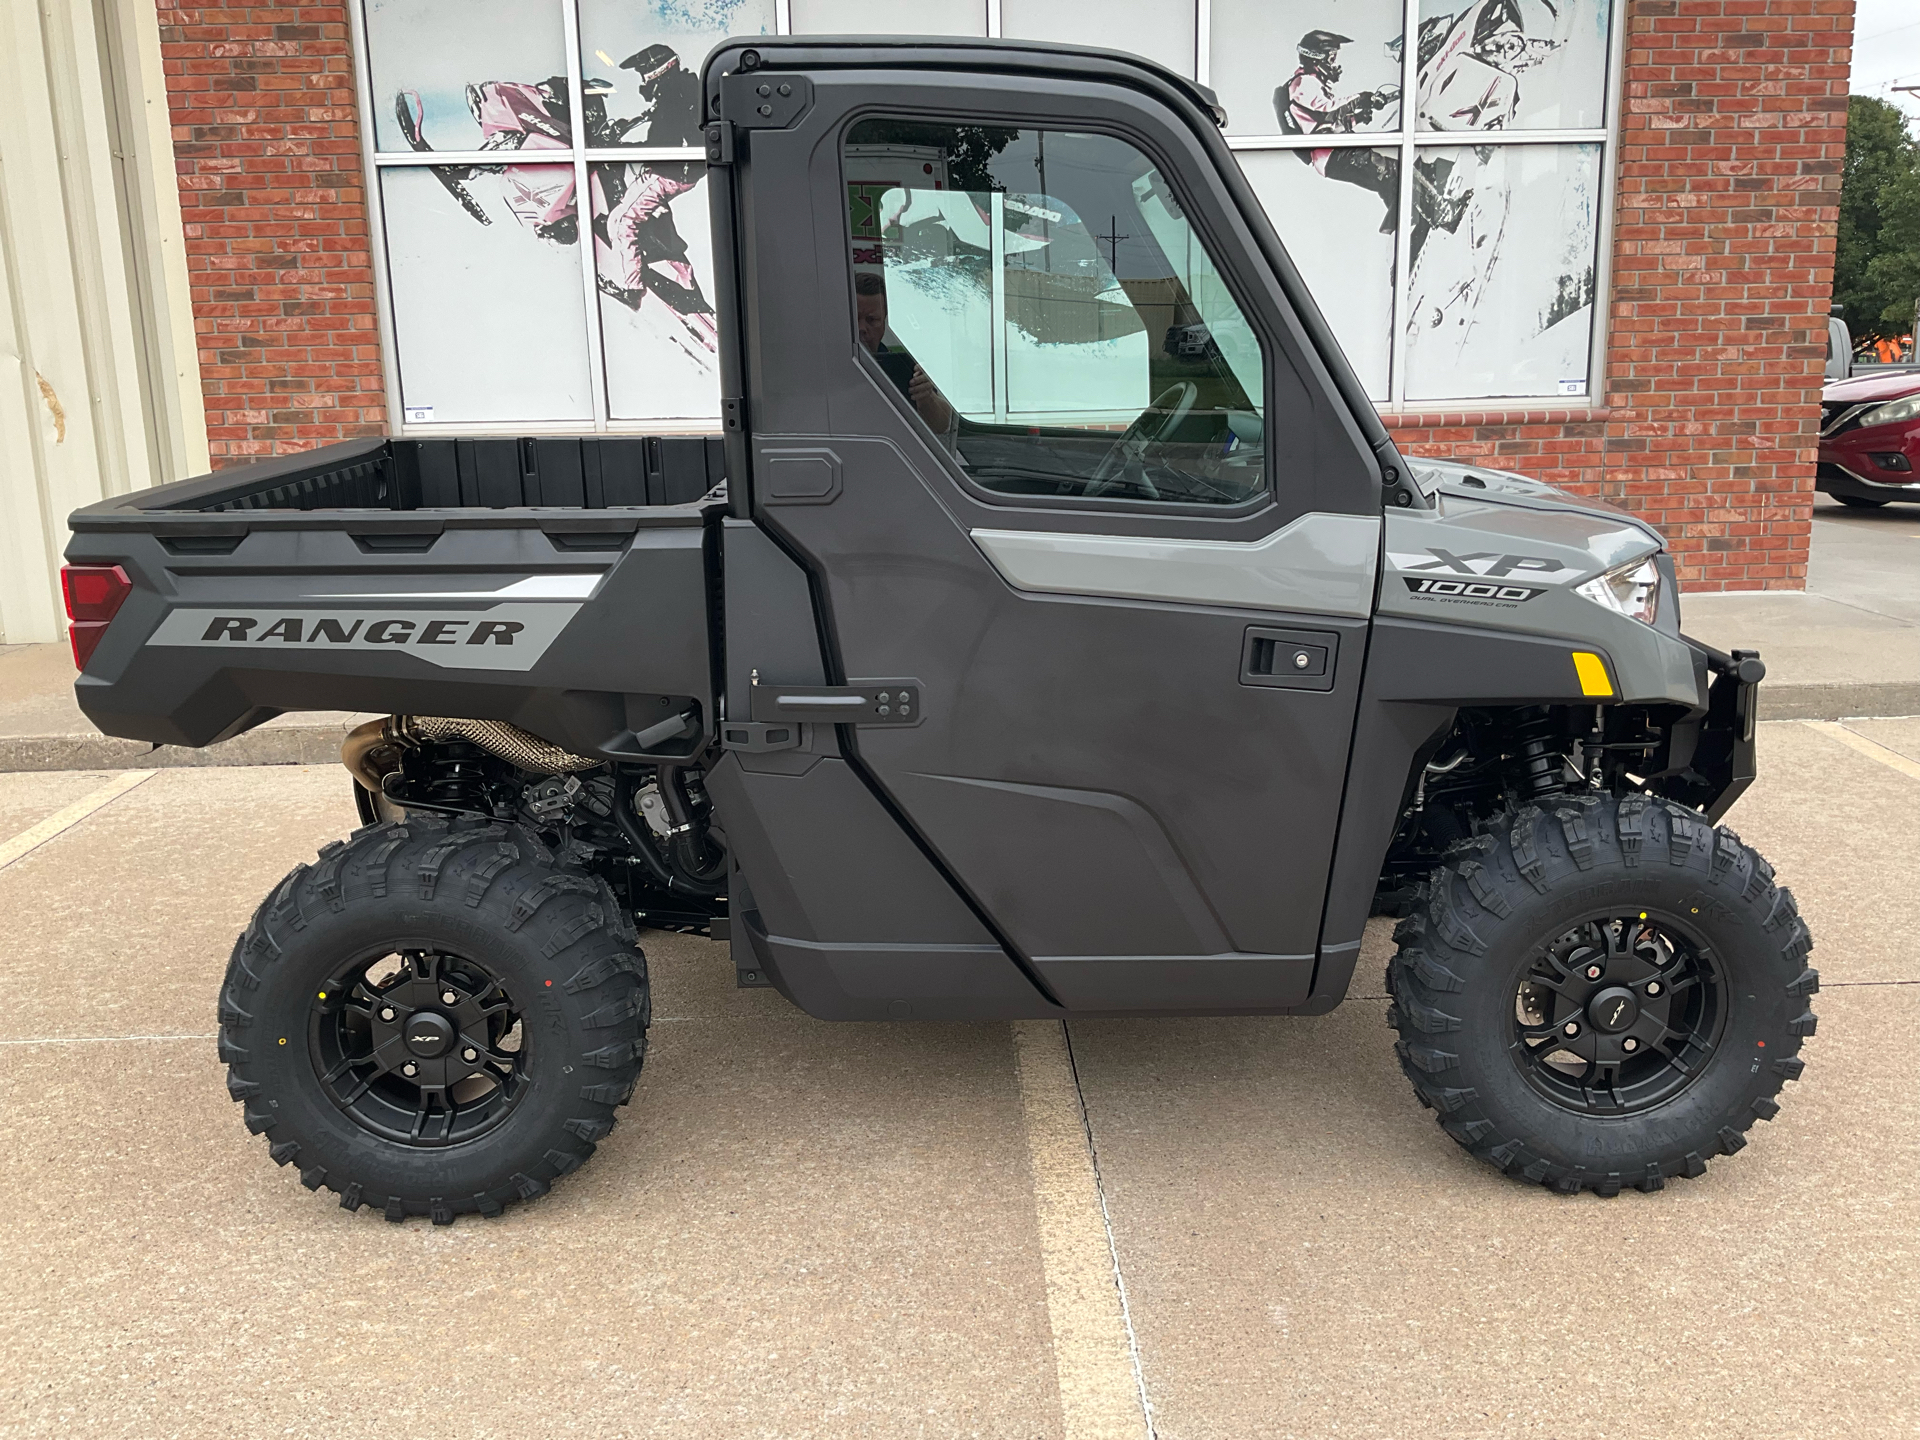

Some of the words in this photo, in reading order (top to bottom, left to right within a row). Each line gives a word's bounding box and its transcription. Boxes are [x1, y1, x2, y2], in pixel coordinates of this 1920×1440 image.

[1402, 548, 1566, 578] XP
[1418, 580, 1532, 601] 1000
[1439, 598, 1494, 607] OVERHEAD
[200, 617, 525, 646] RANGER
